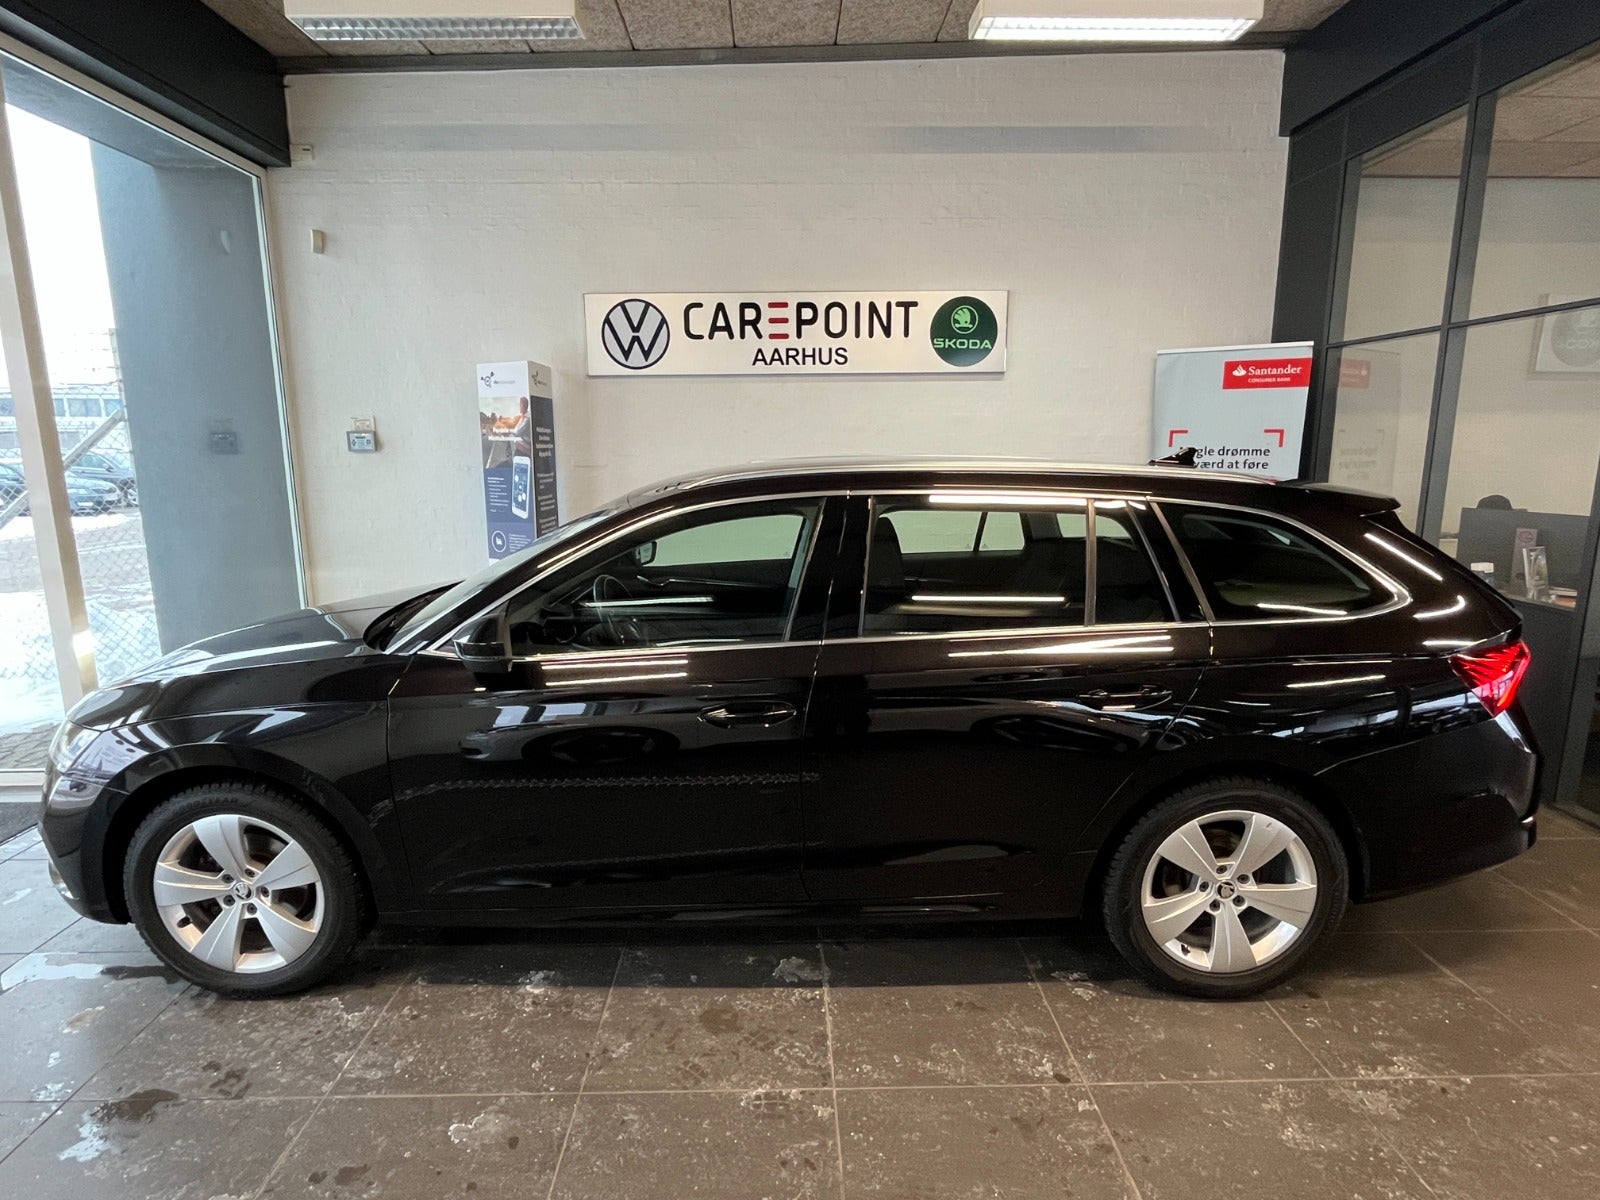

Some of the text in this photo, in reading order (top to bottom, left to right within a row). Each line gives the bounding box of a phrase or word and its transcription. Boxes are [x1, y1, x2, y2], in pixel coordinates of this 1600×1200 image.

[683, 301, 919, 340] CAREPOINT
[933, 338, 992, 349] SKODA
[752, 347, 848, 366] AARHUS
[1248, 364, 1302, 376] Santander
[1217, 446, 1271, 457] drømme
[1227, 461, 1240, 469] at
[1242, 459, 1269, 469] føre
